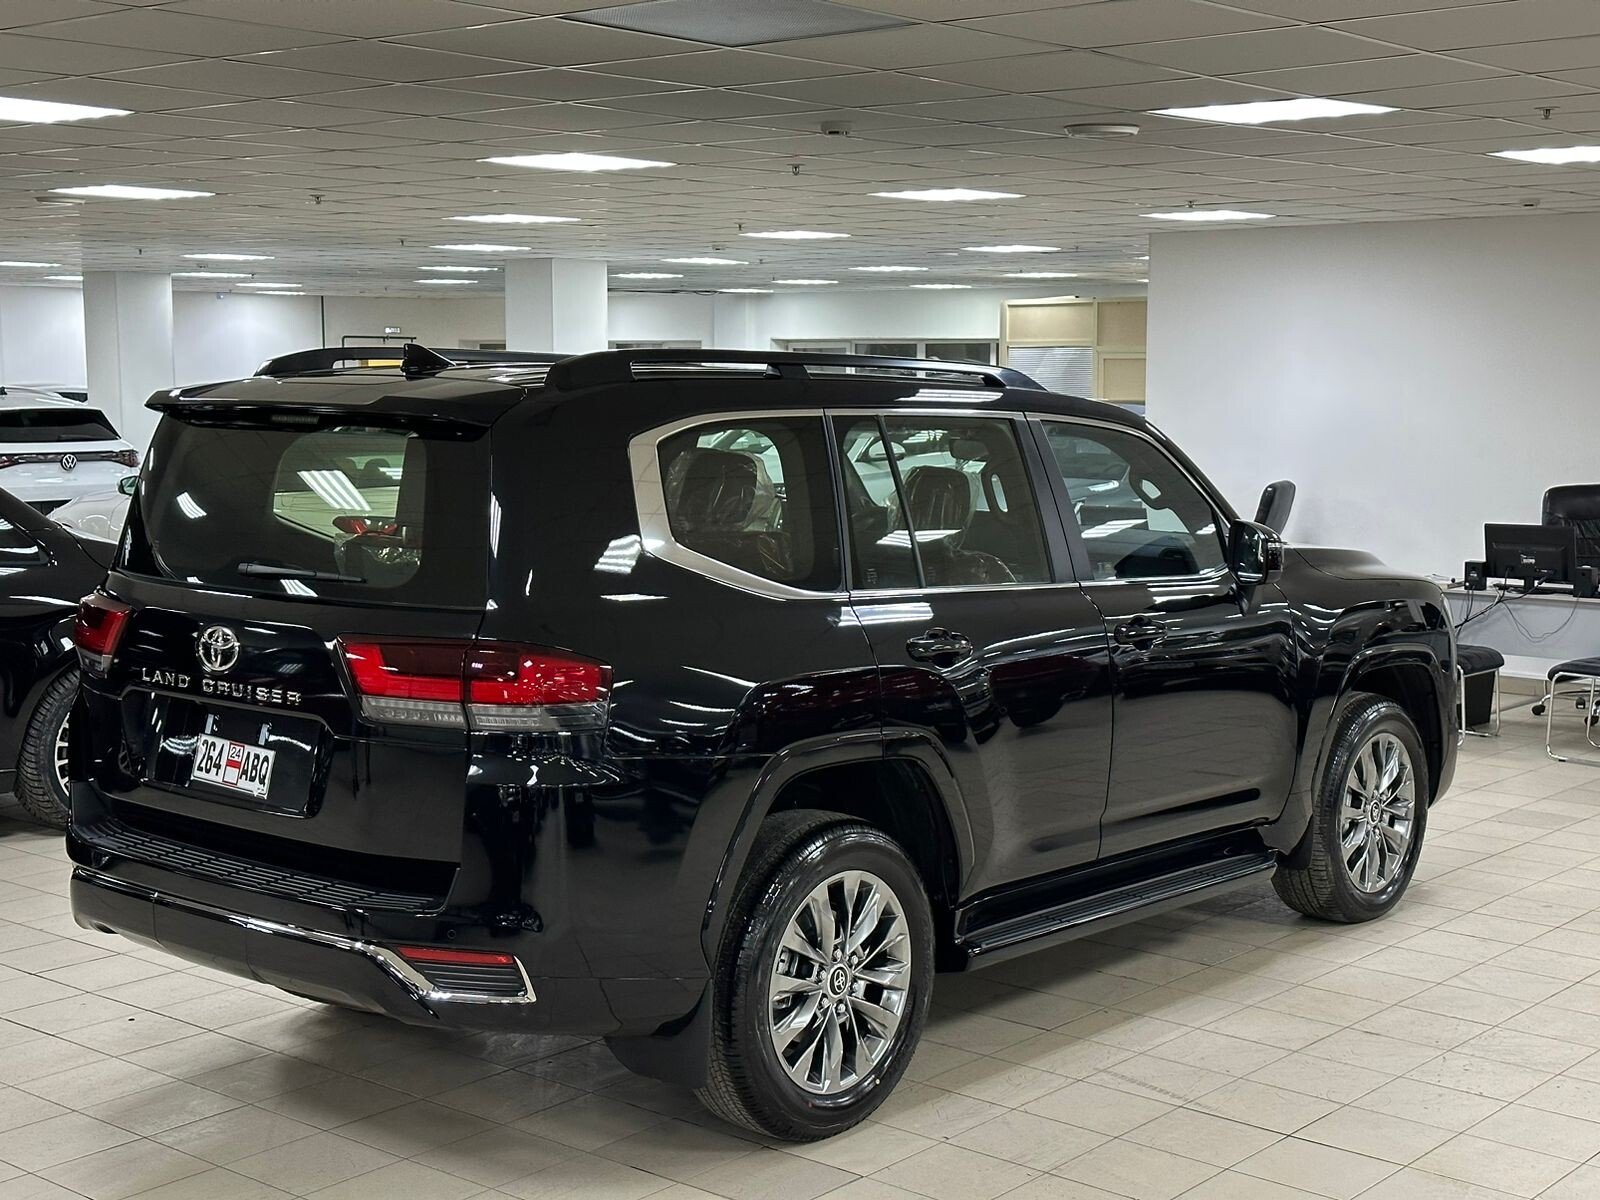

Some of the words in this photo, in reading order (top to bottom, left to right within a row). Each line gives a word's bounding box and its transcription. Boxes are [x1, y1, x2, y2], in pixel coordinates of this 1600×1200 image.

[141, 667, 191, 688] LAND
[202, 678, 302, 706] CRUISER
[196, 739, 225, 777] 264
[229, 746, 242, 760] 24
[239, 751, 270, 787] ABQ
